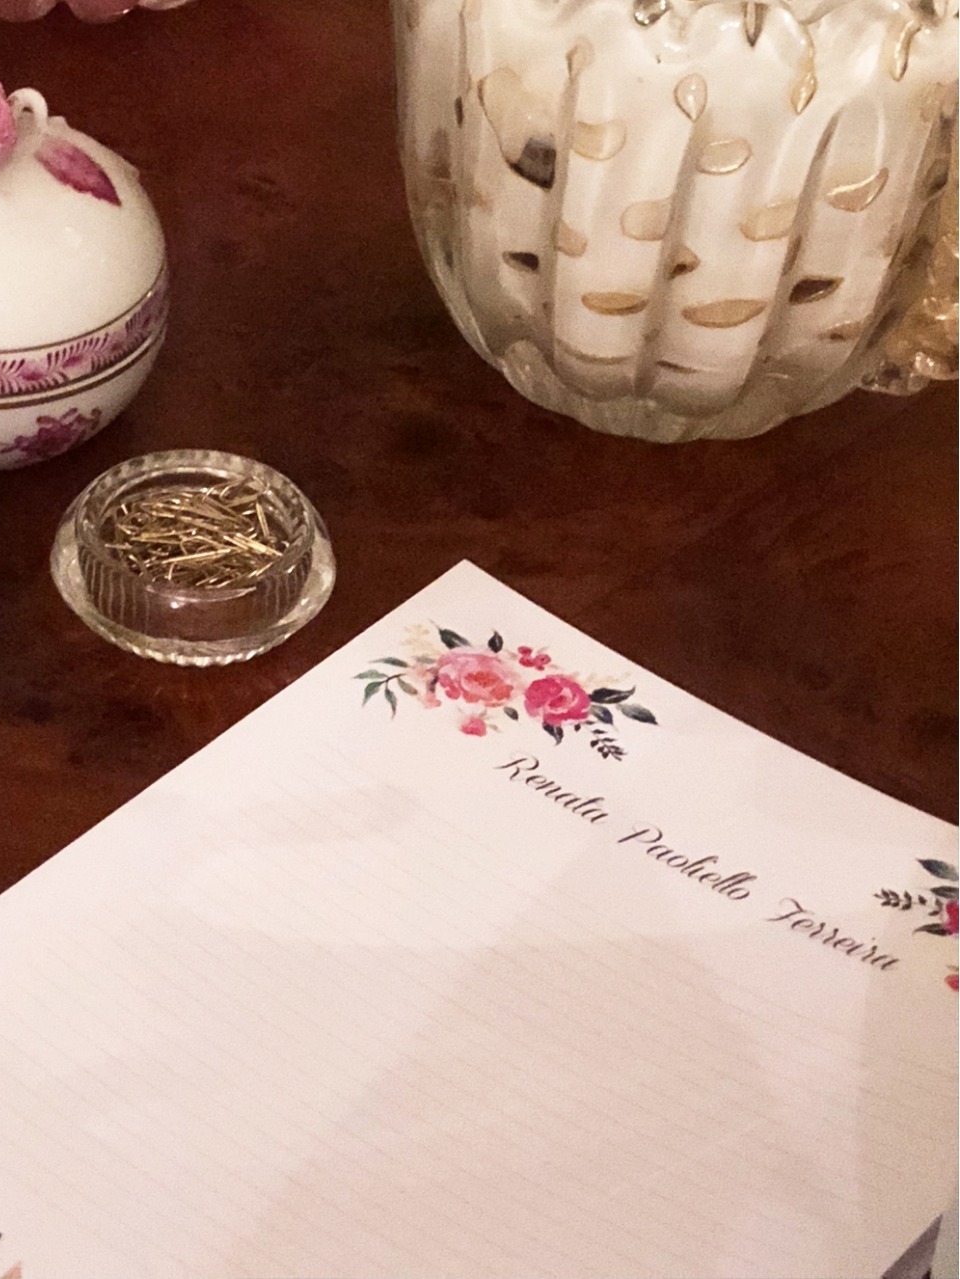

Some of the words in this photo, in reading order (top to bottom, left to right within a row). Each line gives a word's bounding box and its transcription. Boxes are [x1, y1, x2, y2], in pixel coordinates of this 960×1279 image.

[494, 754, 608, 823] Renata
[617, 823, 757, 901] Paoliello
[766, 898, 900, 970] Ferreira
